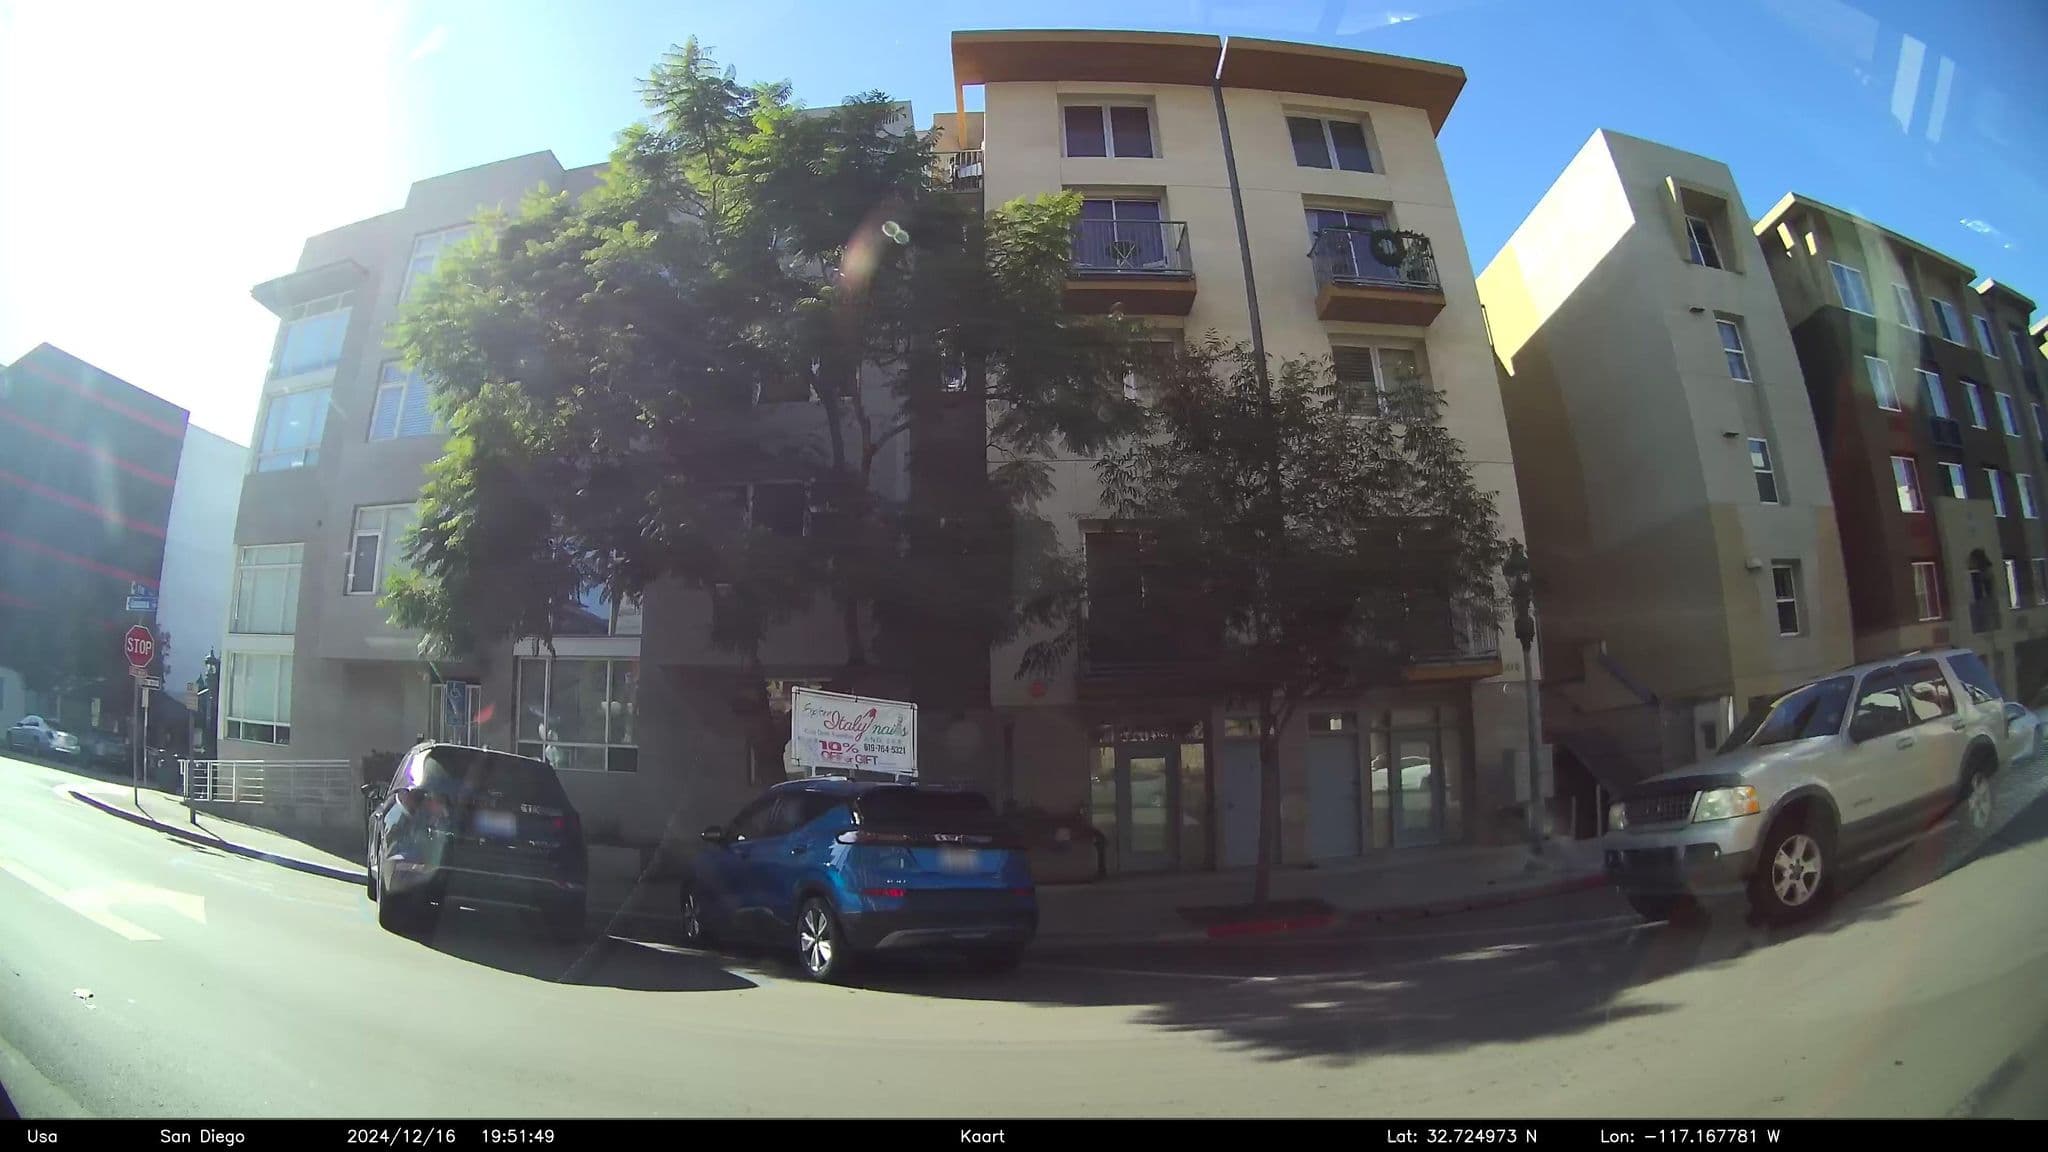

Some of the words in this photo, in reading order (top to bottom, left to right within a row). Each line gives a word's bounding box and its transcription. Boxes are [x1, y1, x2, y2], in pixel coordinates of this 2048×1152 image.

[127, 637, 152, 655] STOP
[823, 710, 872, 742] Italy
[819, 740, 859, 753] 10%
[855, 754, 878, 765] GIFT
